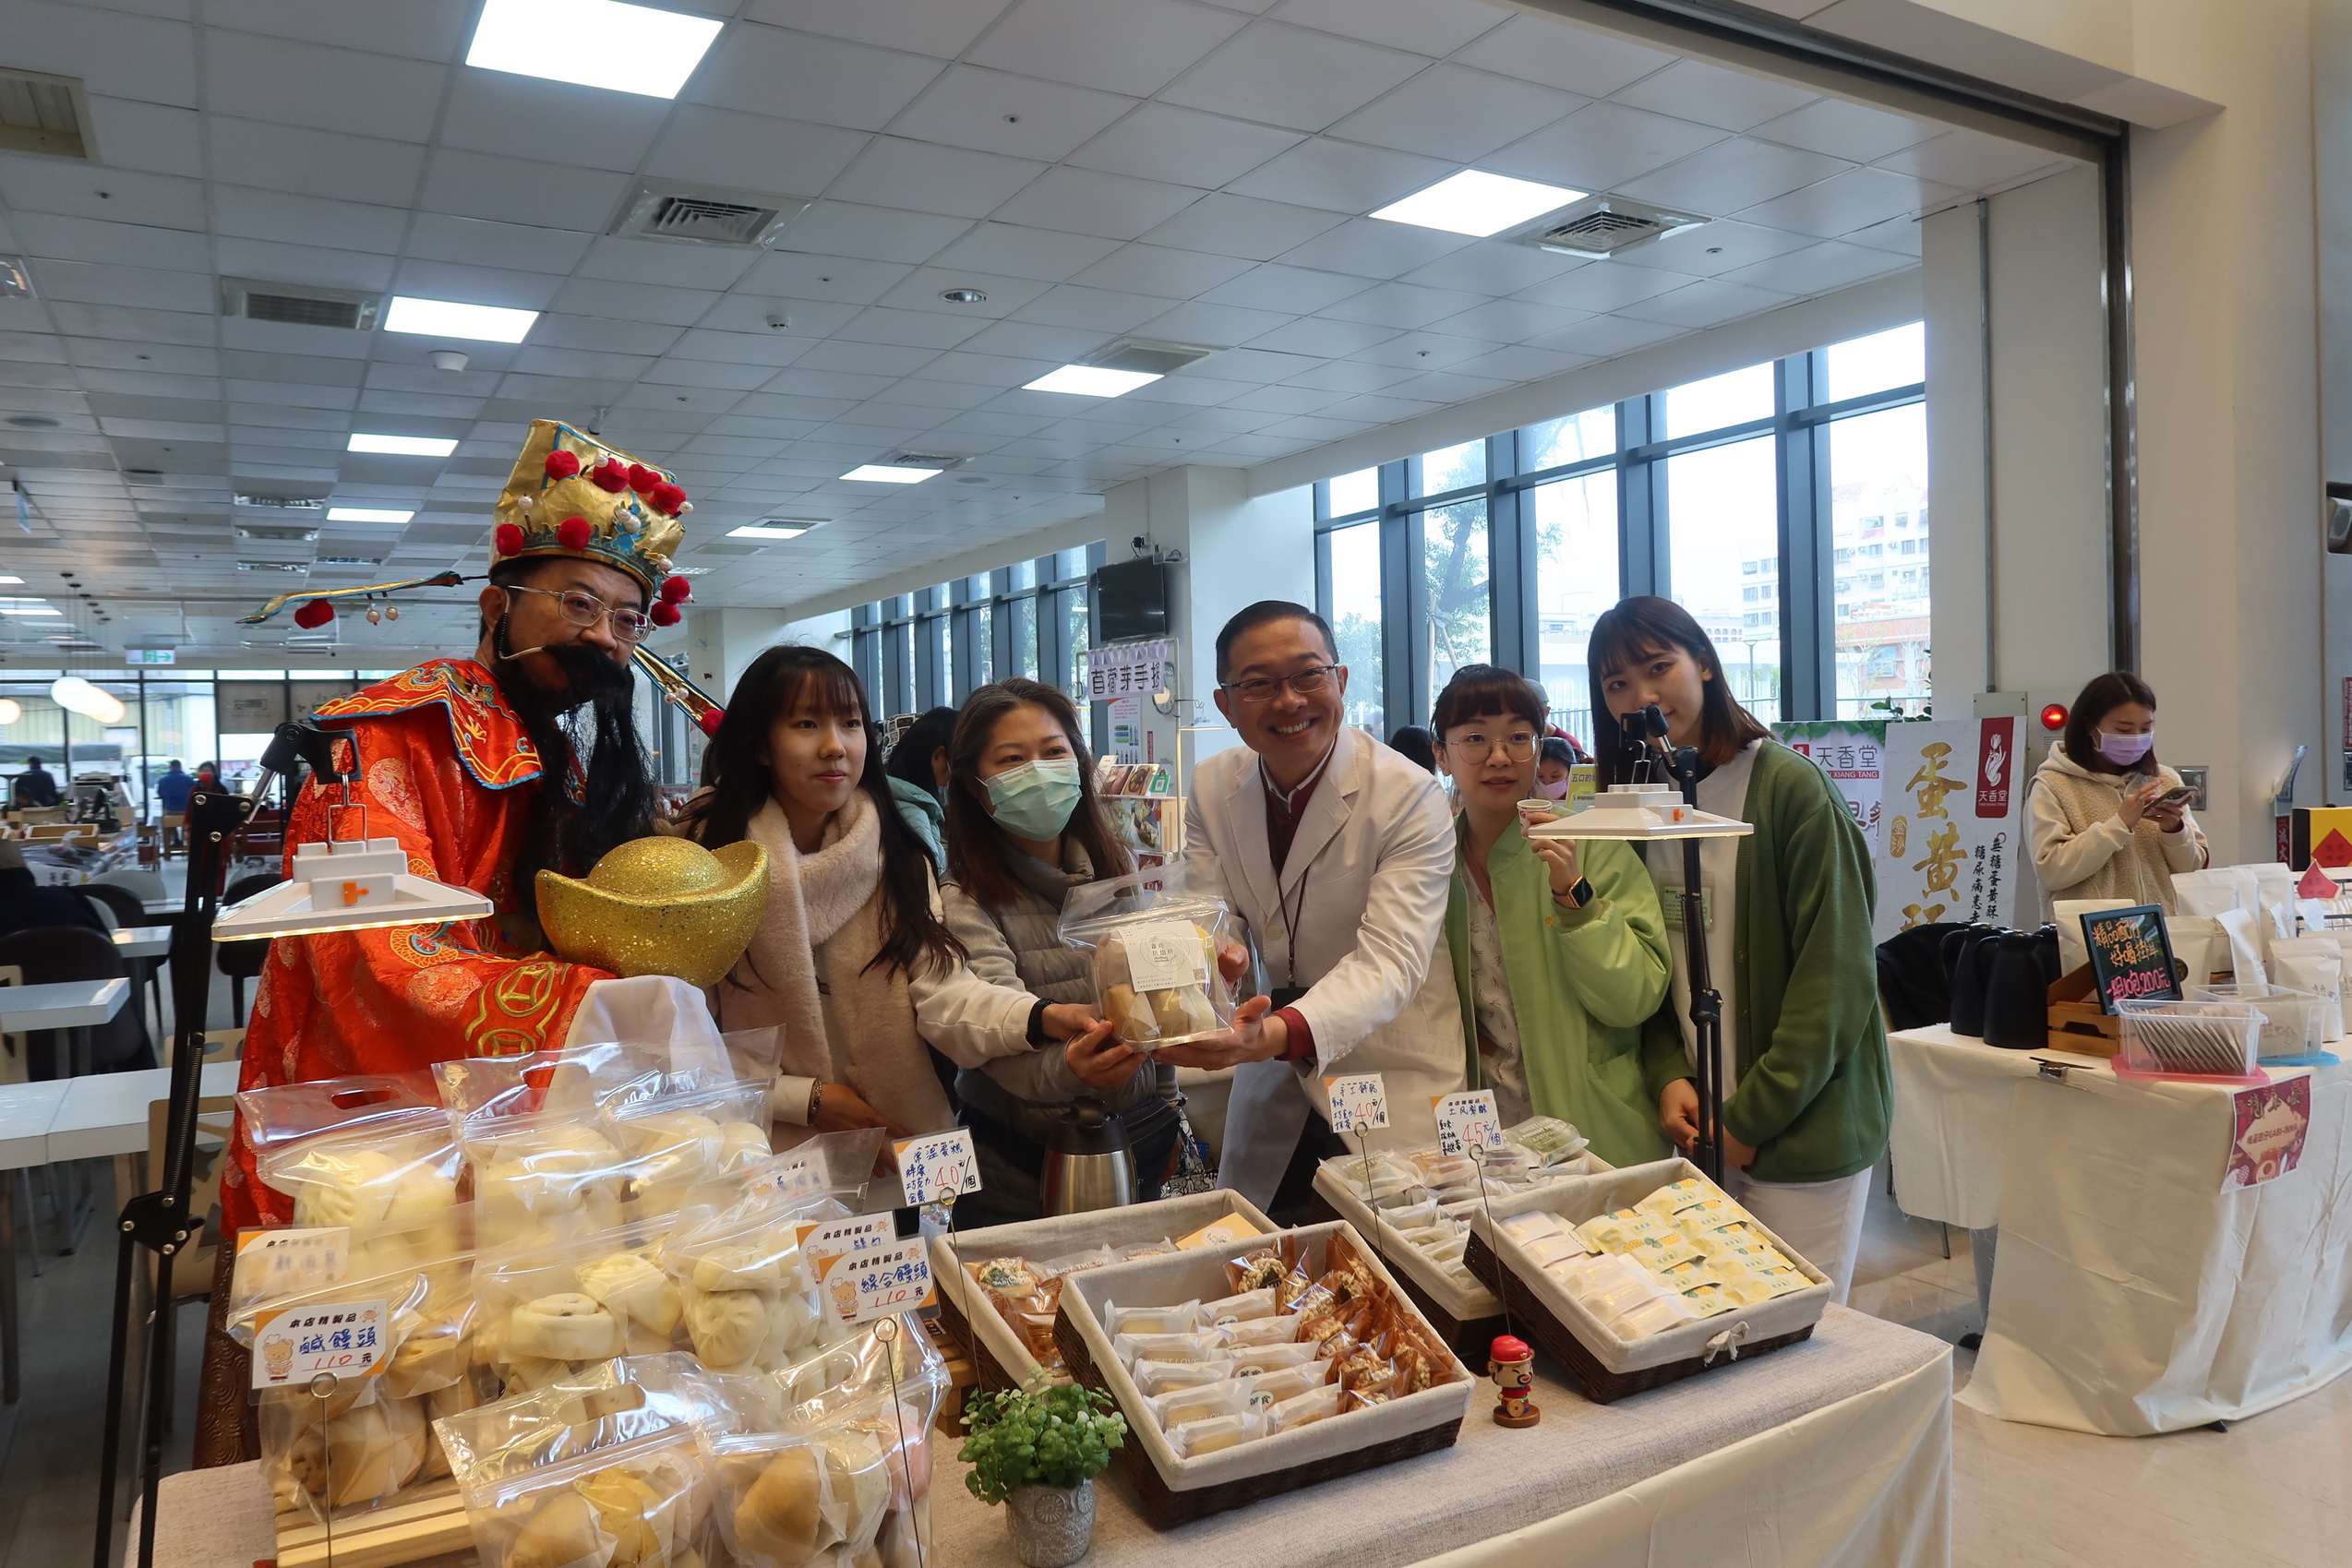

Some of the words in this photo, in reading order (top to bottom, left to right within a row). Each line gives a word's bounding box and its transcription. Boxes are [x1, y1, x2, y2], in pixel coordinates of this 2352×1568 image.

[1816, 745, 1878, 769] 天香堂
[1978, 789, 2008, 802] 天香堂
[823, 1224, 872, 1240] 本店精製品
[848, 1251, 903, 1271] 本店精製品
[1074, 1262, 1094, 1270] THE
[861, 1261, 929, 1294] 綜合饅頭
[915, 1287, 924, 1297] 元
[289, 1313, 357, 1328] 本店精製品
[299, 1326, 378, 1355] 鹹饅頭
[362, 1352, 372, 1363] 元
